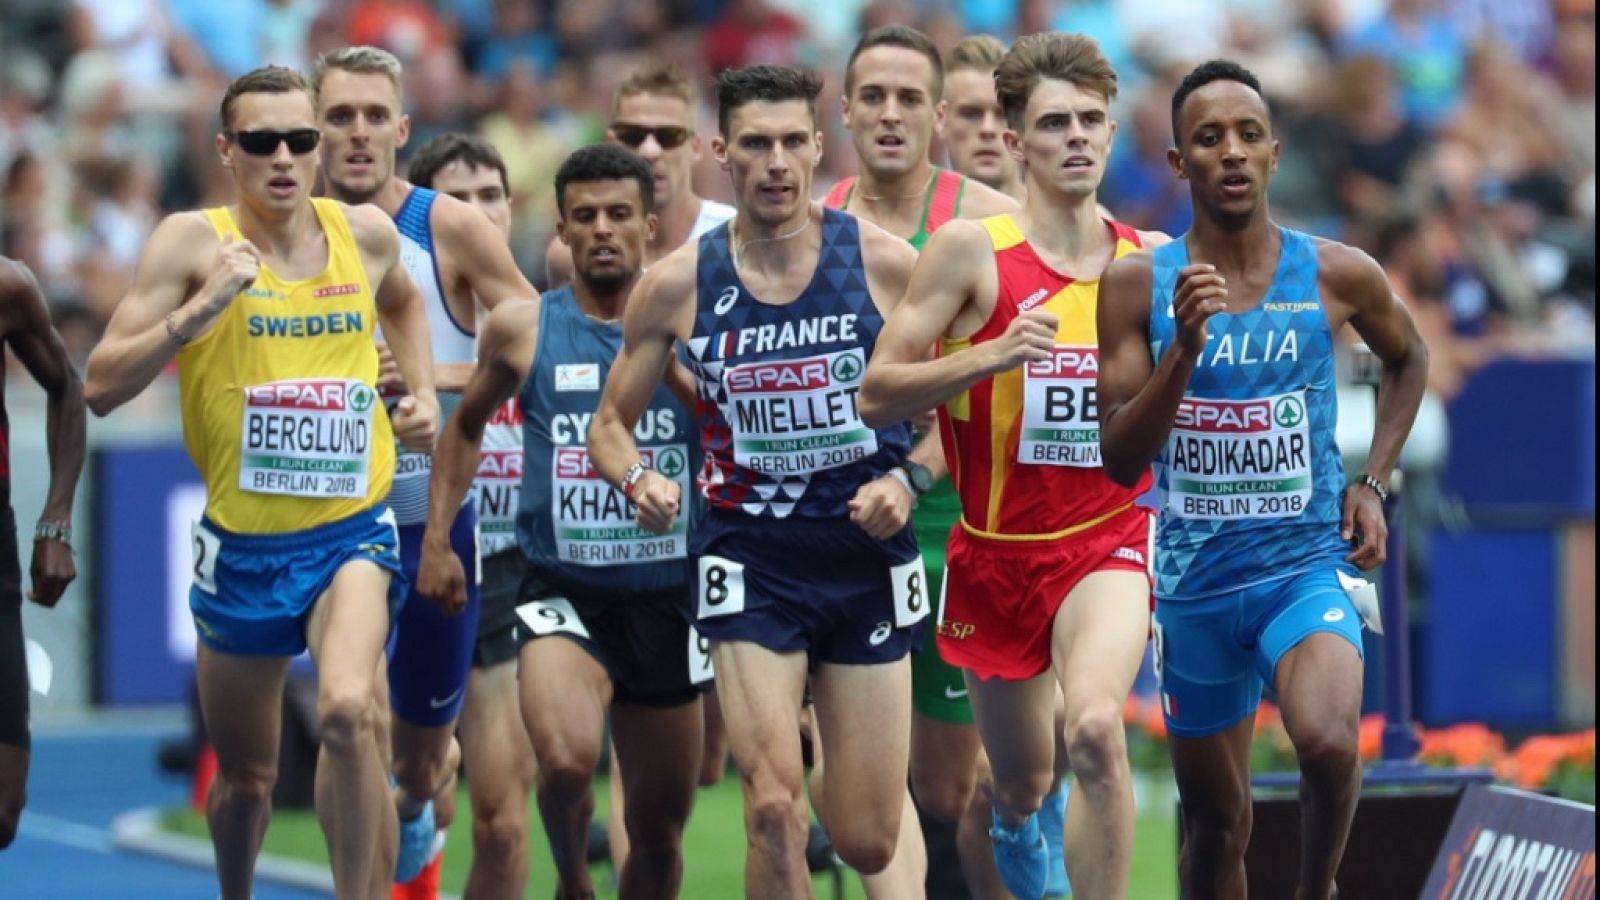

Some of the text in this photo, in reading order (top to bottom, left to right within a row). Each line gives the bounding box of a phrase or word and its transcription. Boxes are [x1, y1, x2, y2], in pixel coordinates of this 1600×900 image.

[248, 311, 363, 338] SWEDEN
[737, 313, 858, 356] FRANCE
[1031, 352, 1098, 375] SPA
[729, 365, 828, 391] SPAR
[250, 384, 344, 407] SPAR
[552, 409, 676, 445] CYUS
[1175, 404, 1270, 429] SPAR
[248, 414, 367, 453] BERGLUND
[750, 446, 865, 473] BERLIN 2018
[1033, 444, 1098, 462] BERLIN
[1173, 433, 1305, 476] ABDIKADAR
[254, 471, 356, 492] BERLIN 2018
[1205, 483, 1232, 494] RUN
[1236, 480, 1276, 491] CLEAN
[1184, 494, 1302, 515] BERLIN 2018
[568, 540, 675, 560] BERLIN 2018
[706, 565, 728, 606] 8
[907, 570, 922, 613] 8
[538, 607, 566, 626] 9
